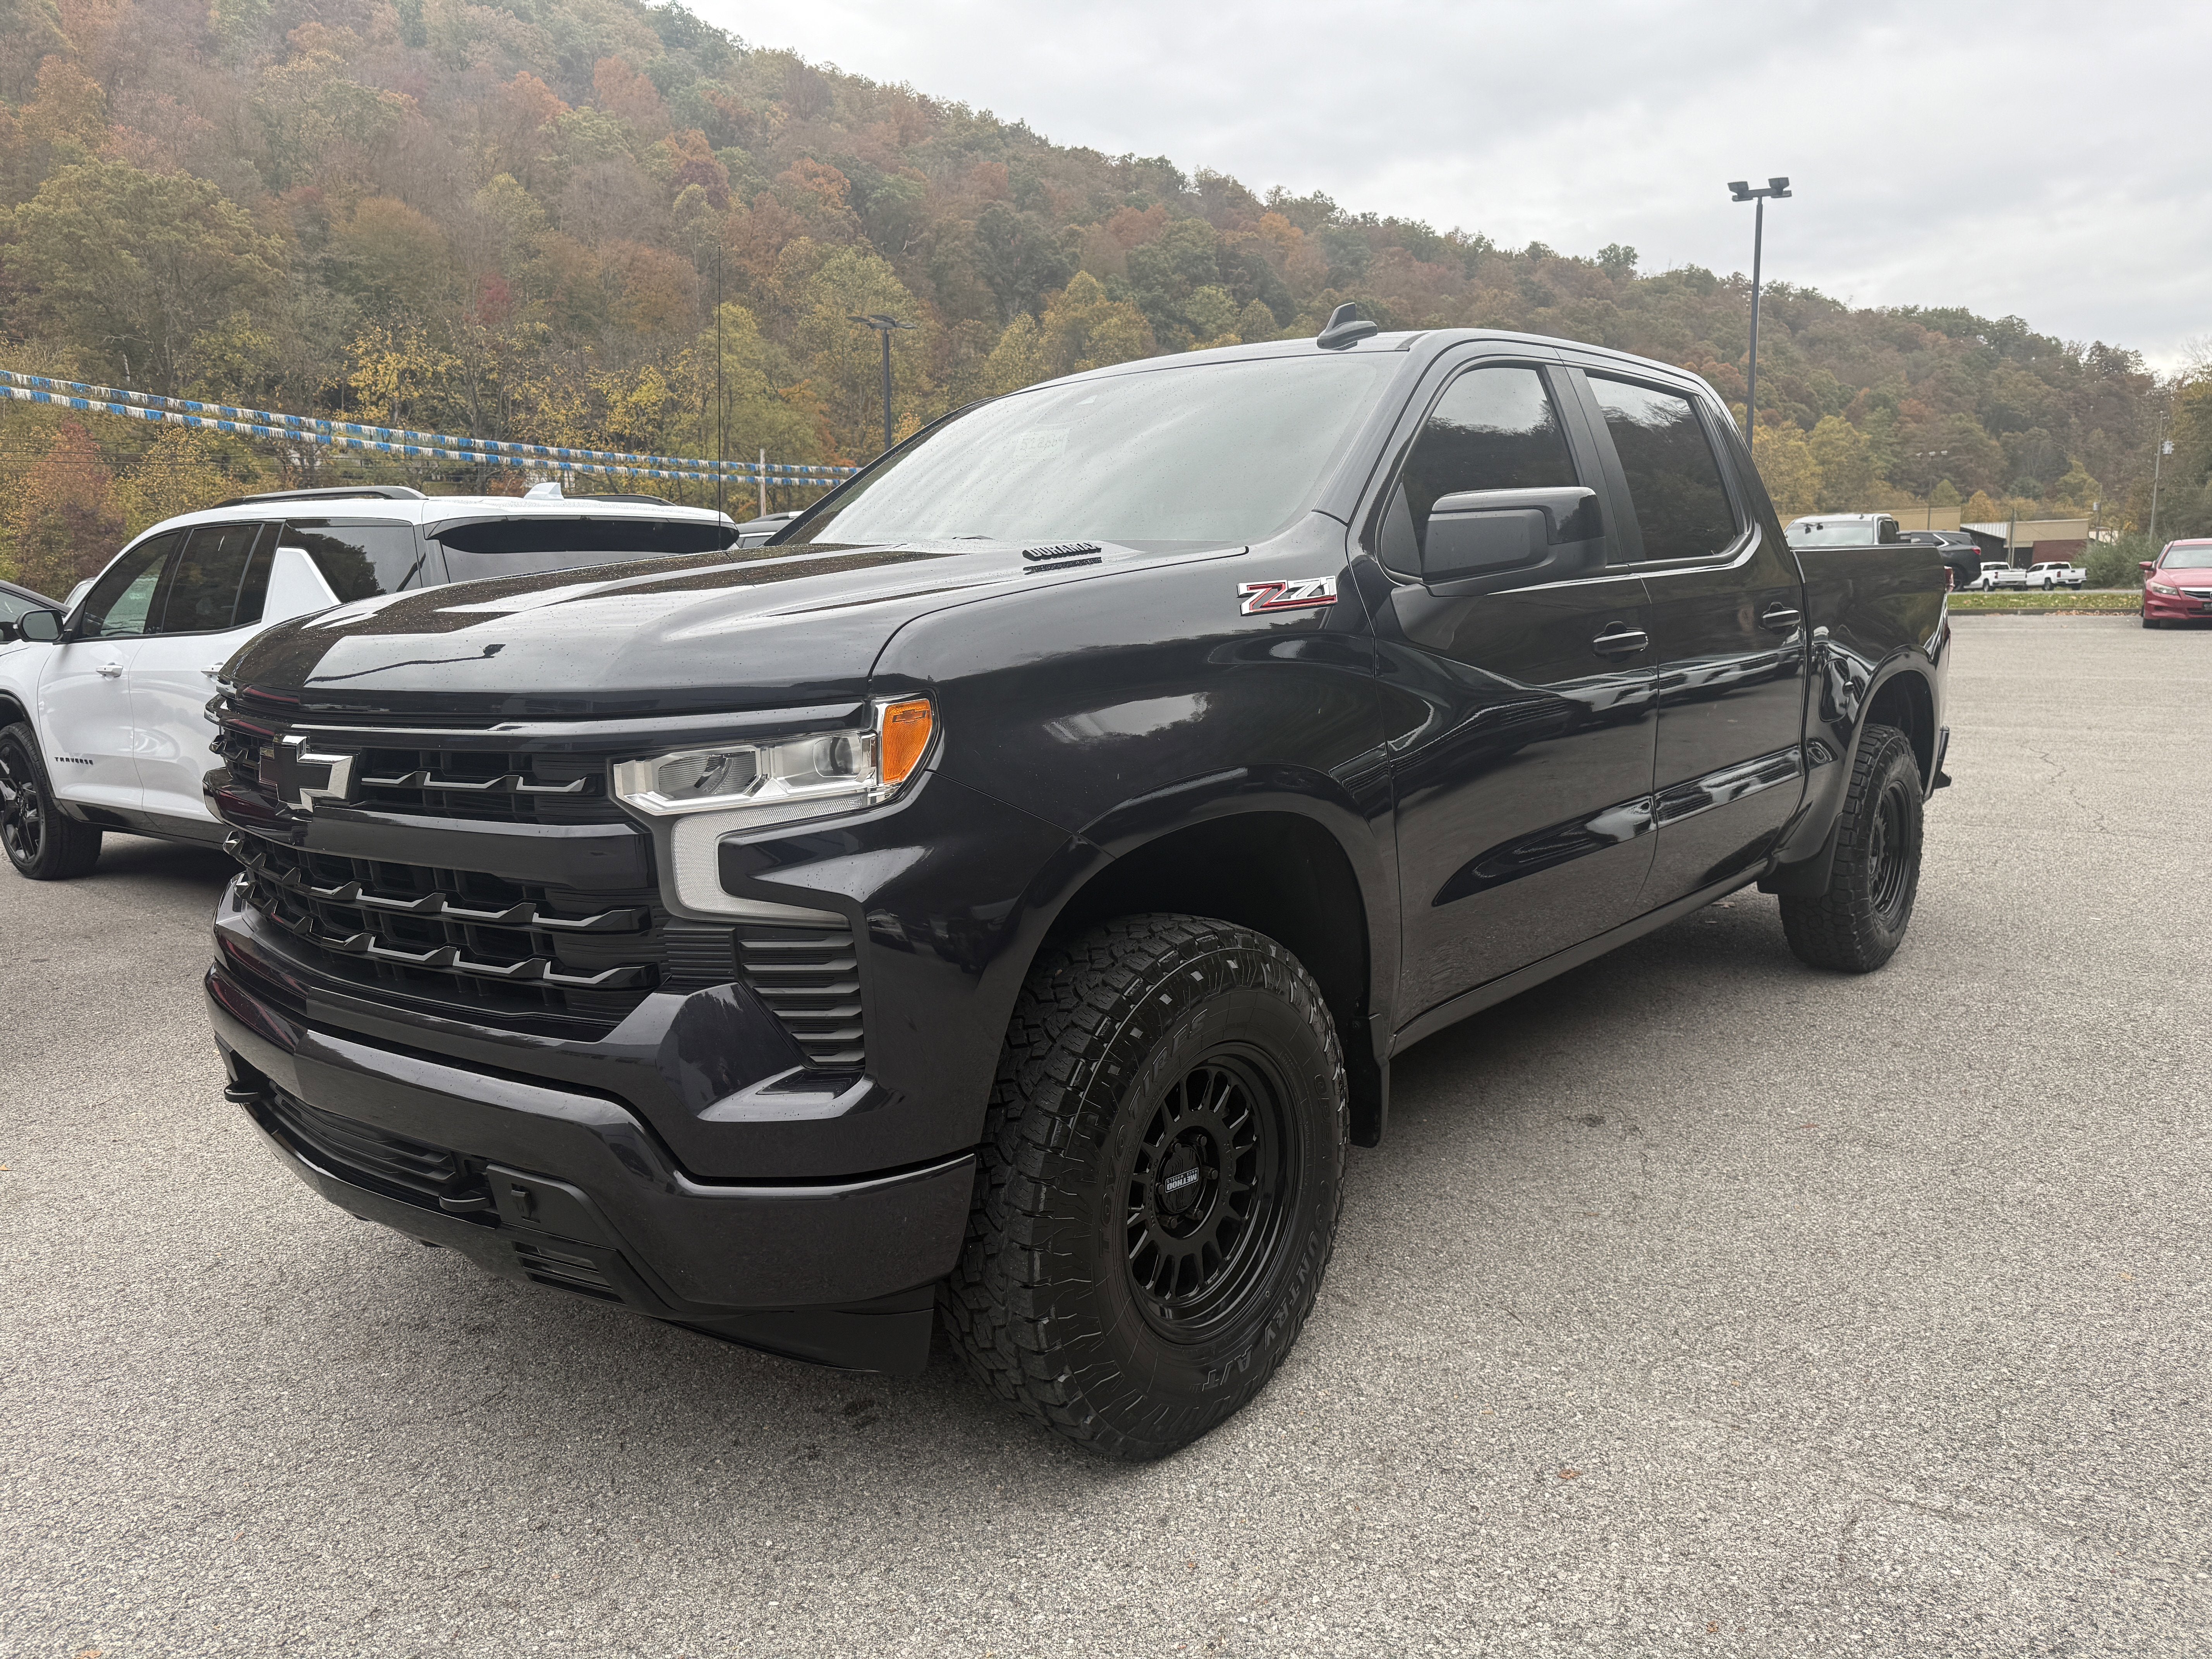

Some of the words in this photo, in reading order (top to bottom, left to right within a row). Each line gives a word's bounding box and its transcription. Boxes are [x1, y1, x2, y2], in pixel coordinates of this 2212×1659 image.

[1023, 542, 1101, 561] DURAMAX
[1237, 576, 1338, 615] Z71
[1098, 1125, 1125, 1258] TOYO
[1128, 1008, 1207, 1120] TIRES
[1167, 1173, 1197, 1190] METHOD
